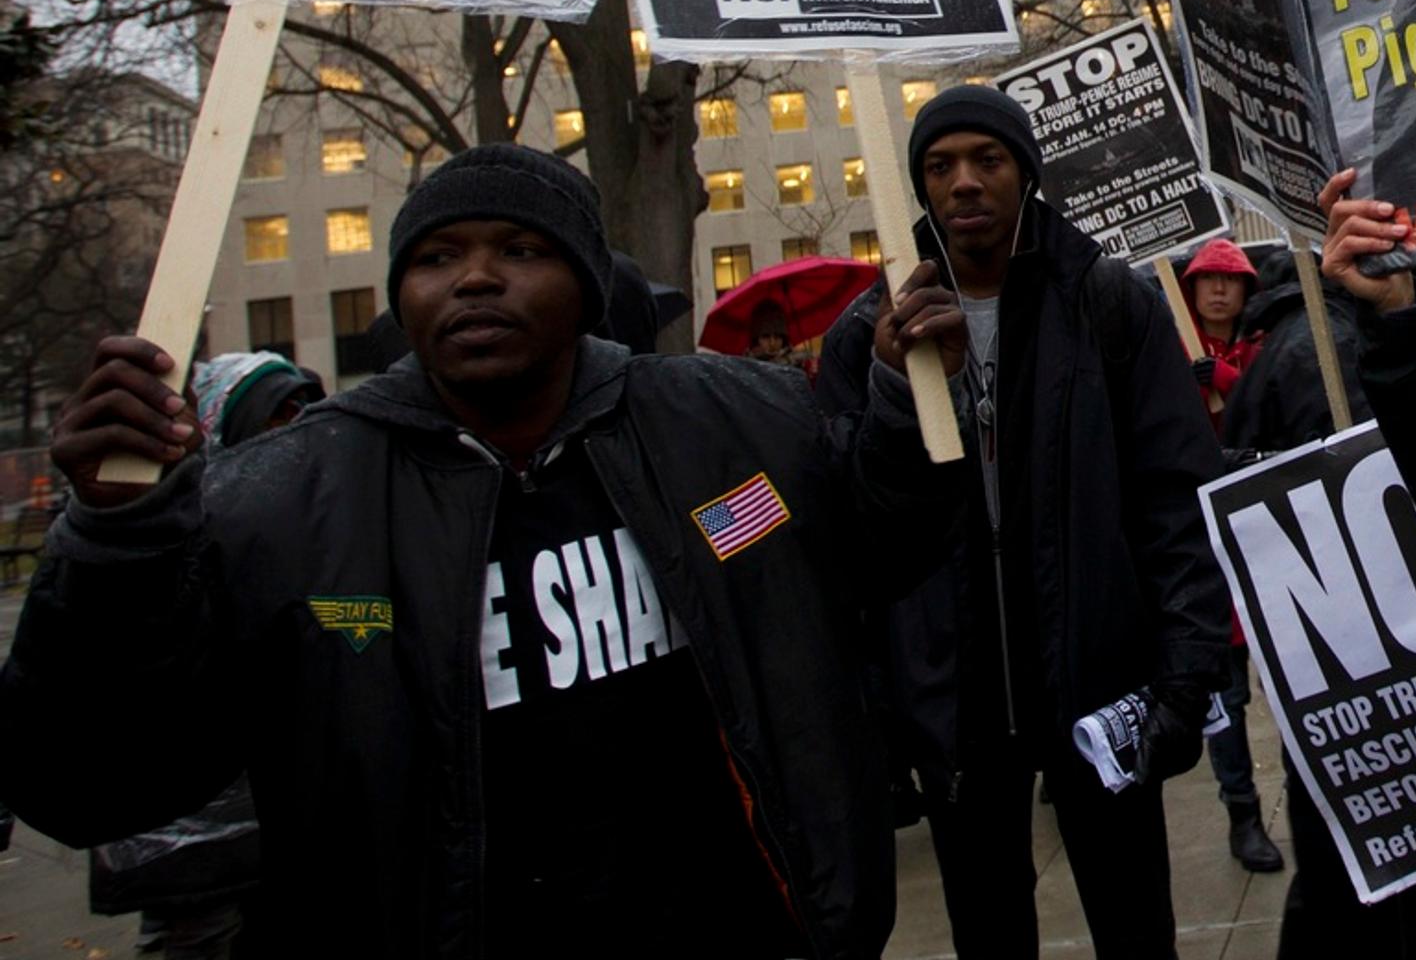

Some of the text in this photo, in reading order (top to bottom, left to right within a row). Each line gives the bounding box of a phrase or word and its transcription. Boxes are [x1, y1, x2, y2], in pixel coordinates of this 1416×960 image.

[1005, 32, 1149, 114] STOP
[1230, 44, 1247, 63] to
[1249, 50, 1280, 76] the
[1038, 82, 1118, 121] TRUMP-PENCE
[1117, 62, 1161, 88] REGIME
[1087, 77, 1165, 119] IT STARTS
[1065, 98, 1165, 147] JAN. 14 4 PM
[1242, 92, 1301, 145] DC TO
[1064, 156, 1179, 208] Take to the Streets
[1104, 189, 1163, 224] DC TO A
[336, 602, 368, 620] STAY
[481, 527, 690, 711] E SHA
[1302, 694, 1374, 750] STOP
